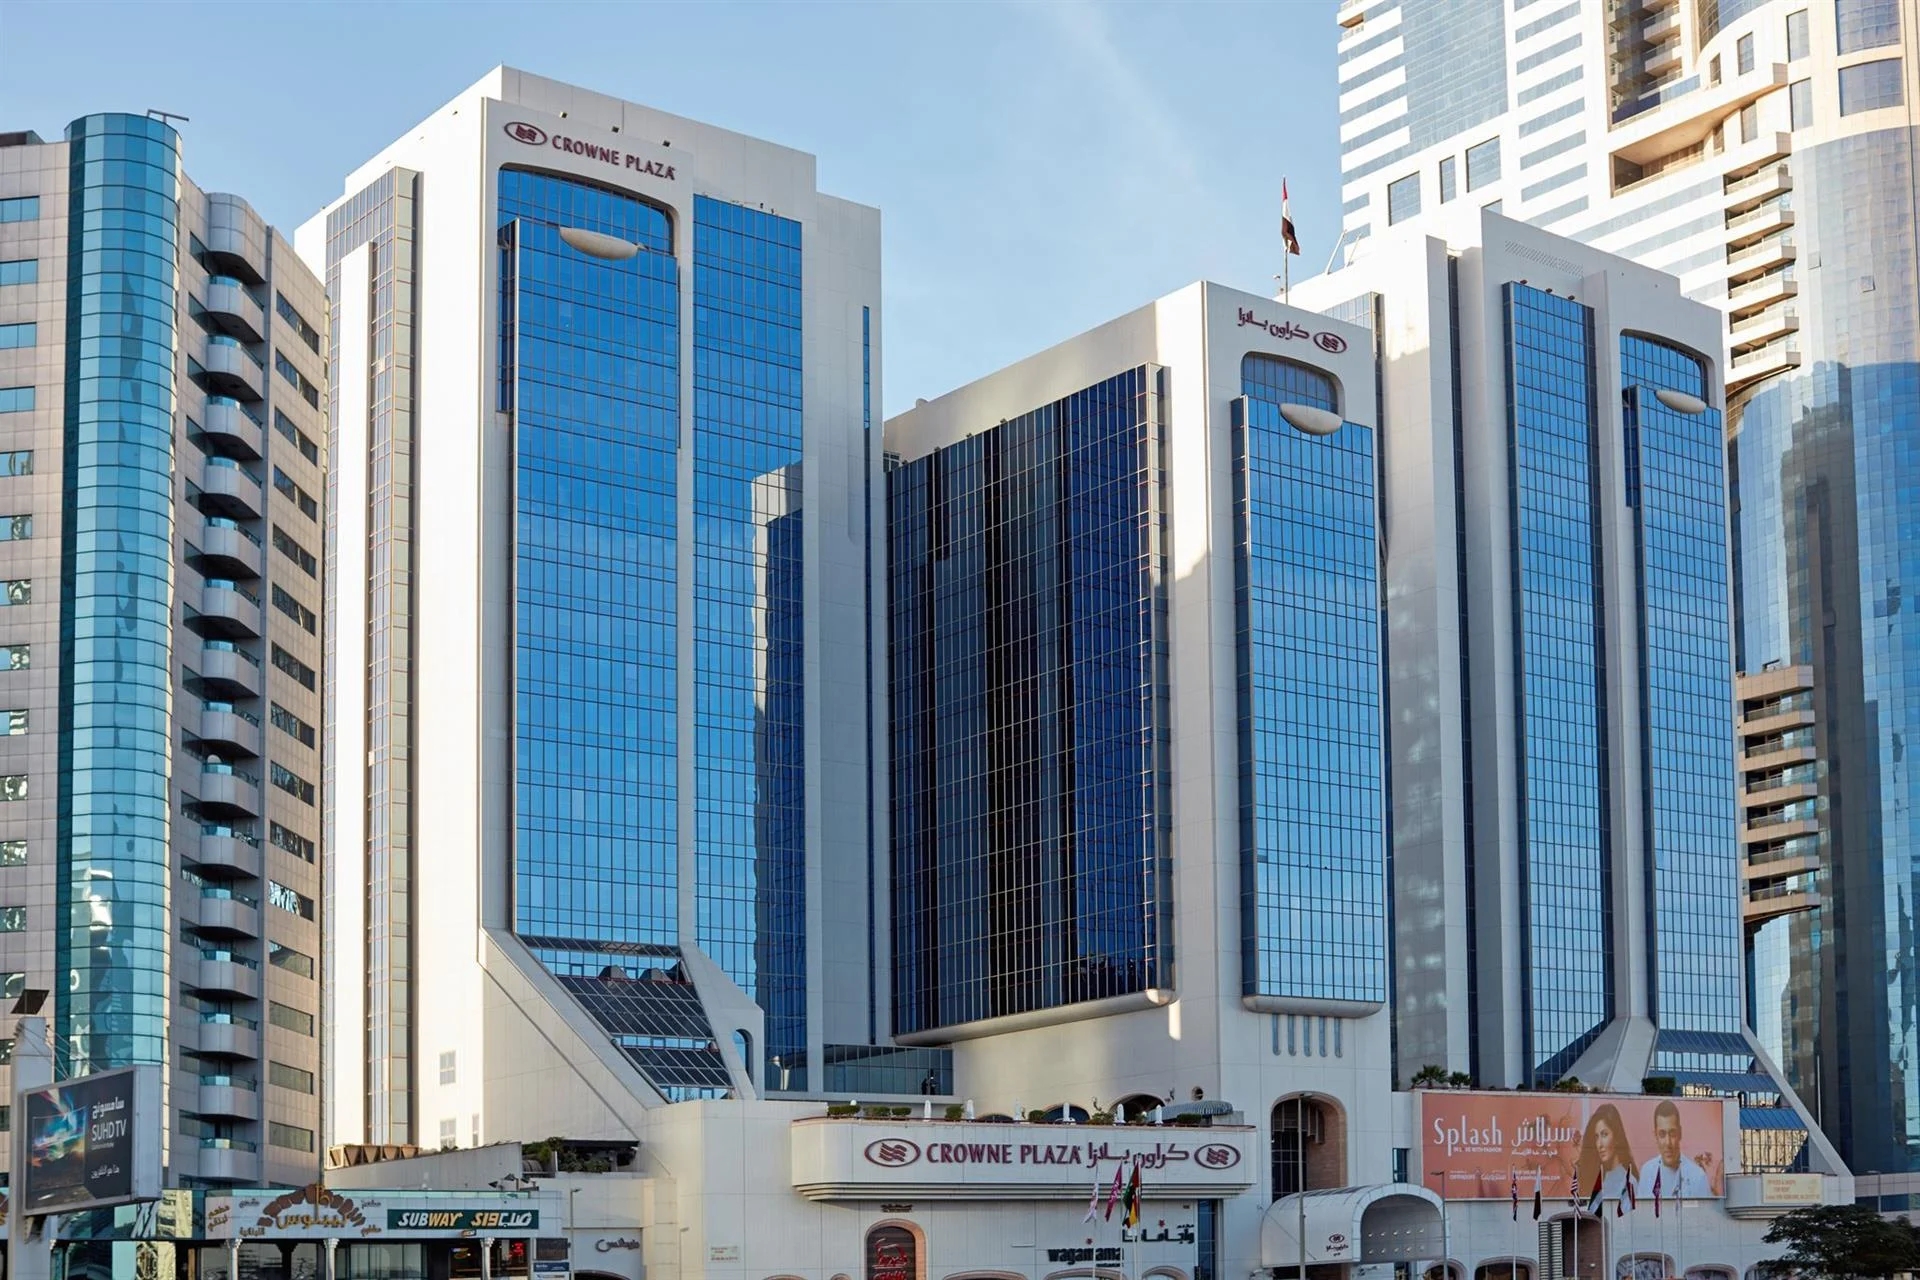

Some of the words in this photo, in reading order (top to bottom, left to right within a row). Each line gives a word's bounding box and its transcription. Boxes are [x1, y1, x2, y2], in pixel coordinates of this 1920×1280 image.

[552, 134, 620, 166] CROWNE
[625, 154, 676, 181] PLAZA
[1237, 307, 1269, 330] بلازا
[1270, 320, 1310, 340] كراون
[92, 1096, 125, 1119] سامسونج
[1433, 1115, 1502, 1157] Splash
[1511, 1116, 1575, 1148] سبلاش
[926, 1142, 1012, 1164] CROWNE
[1020, 1144, 1082, 1165] PLAZA
[1087, 1141, 1130, 1169] بلازا
[1132, 1143, 1190, 1169] كراون
[398, 1211, 463, 1227] SUBWAY
[1048, 1247, 1124, 1265] wagamama
